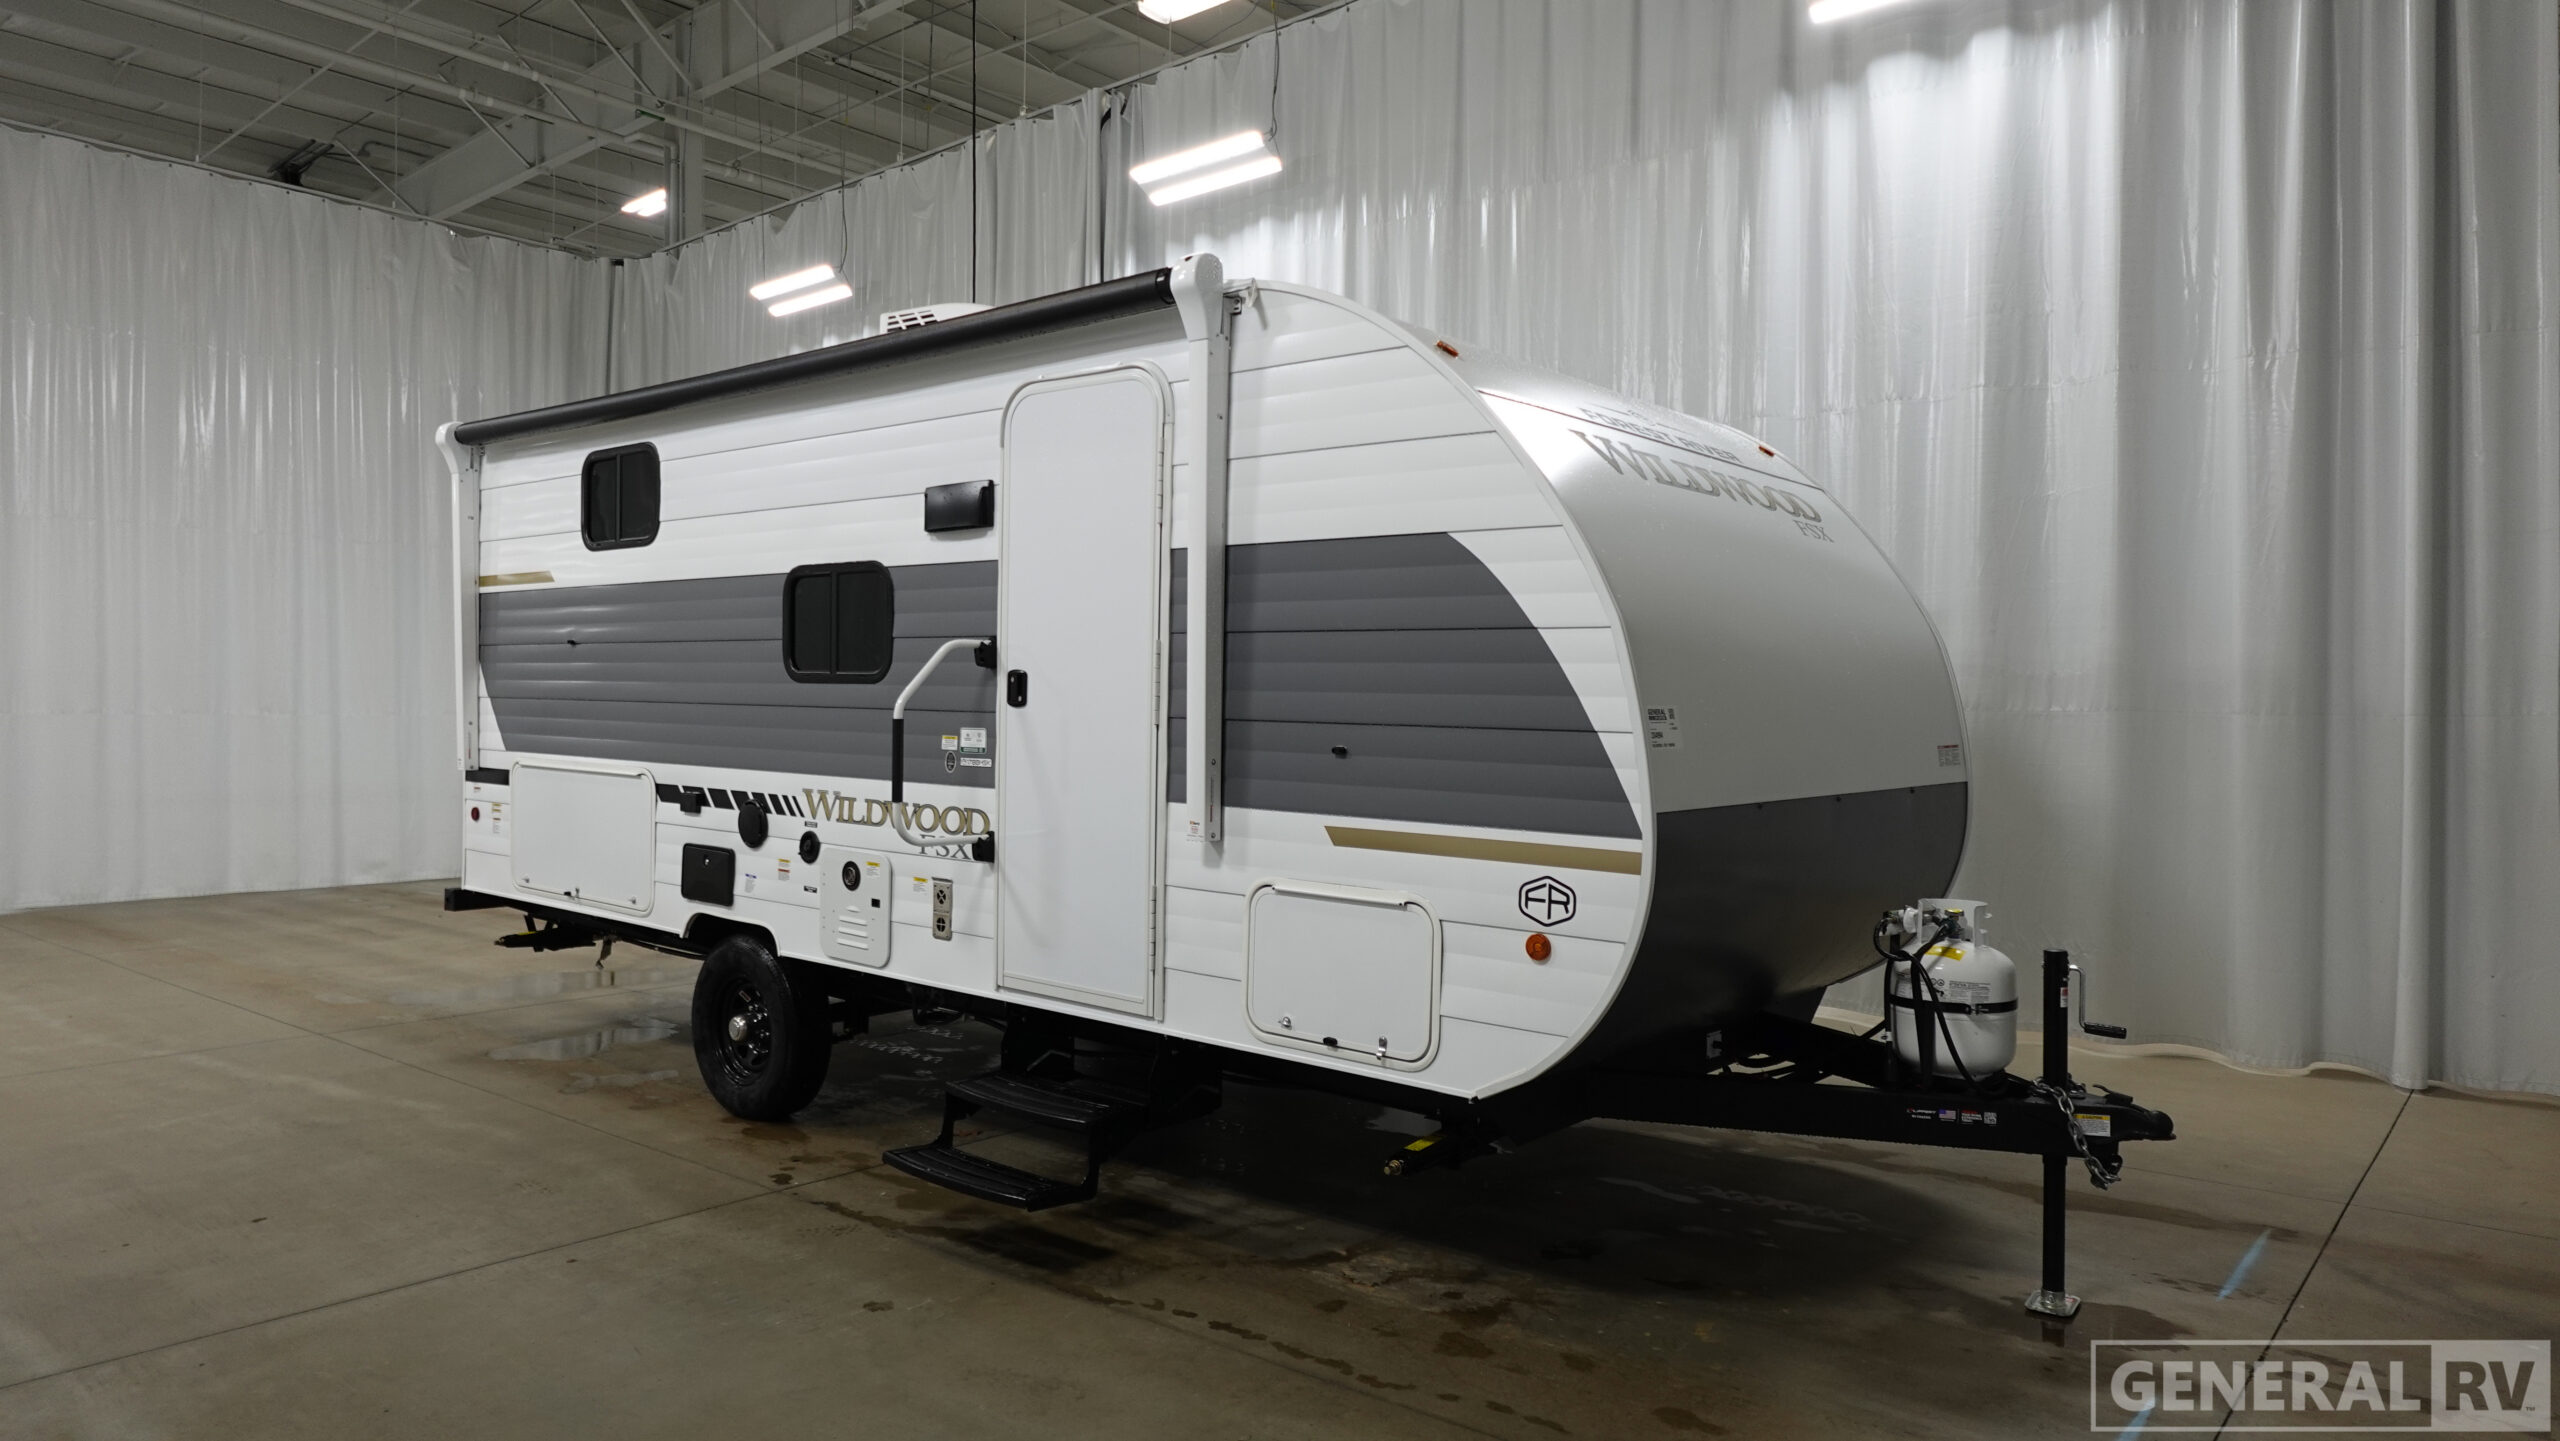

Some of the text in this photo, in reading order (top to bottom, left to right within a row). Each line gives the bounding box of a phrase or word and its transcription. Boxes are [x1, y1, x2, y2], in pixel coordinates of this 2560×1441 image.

[1579, 407, 1742, 463] FOREST RIVER
[1568, 428, 1822, 523] WILDWOOD
[1793, 519, 1834, 543] FSX
[802, 788, 991, 836] WILDWOOD
